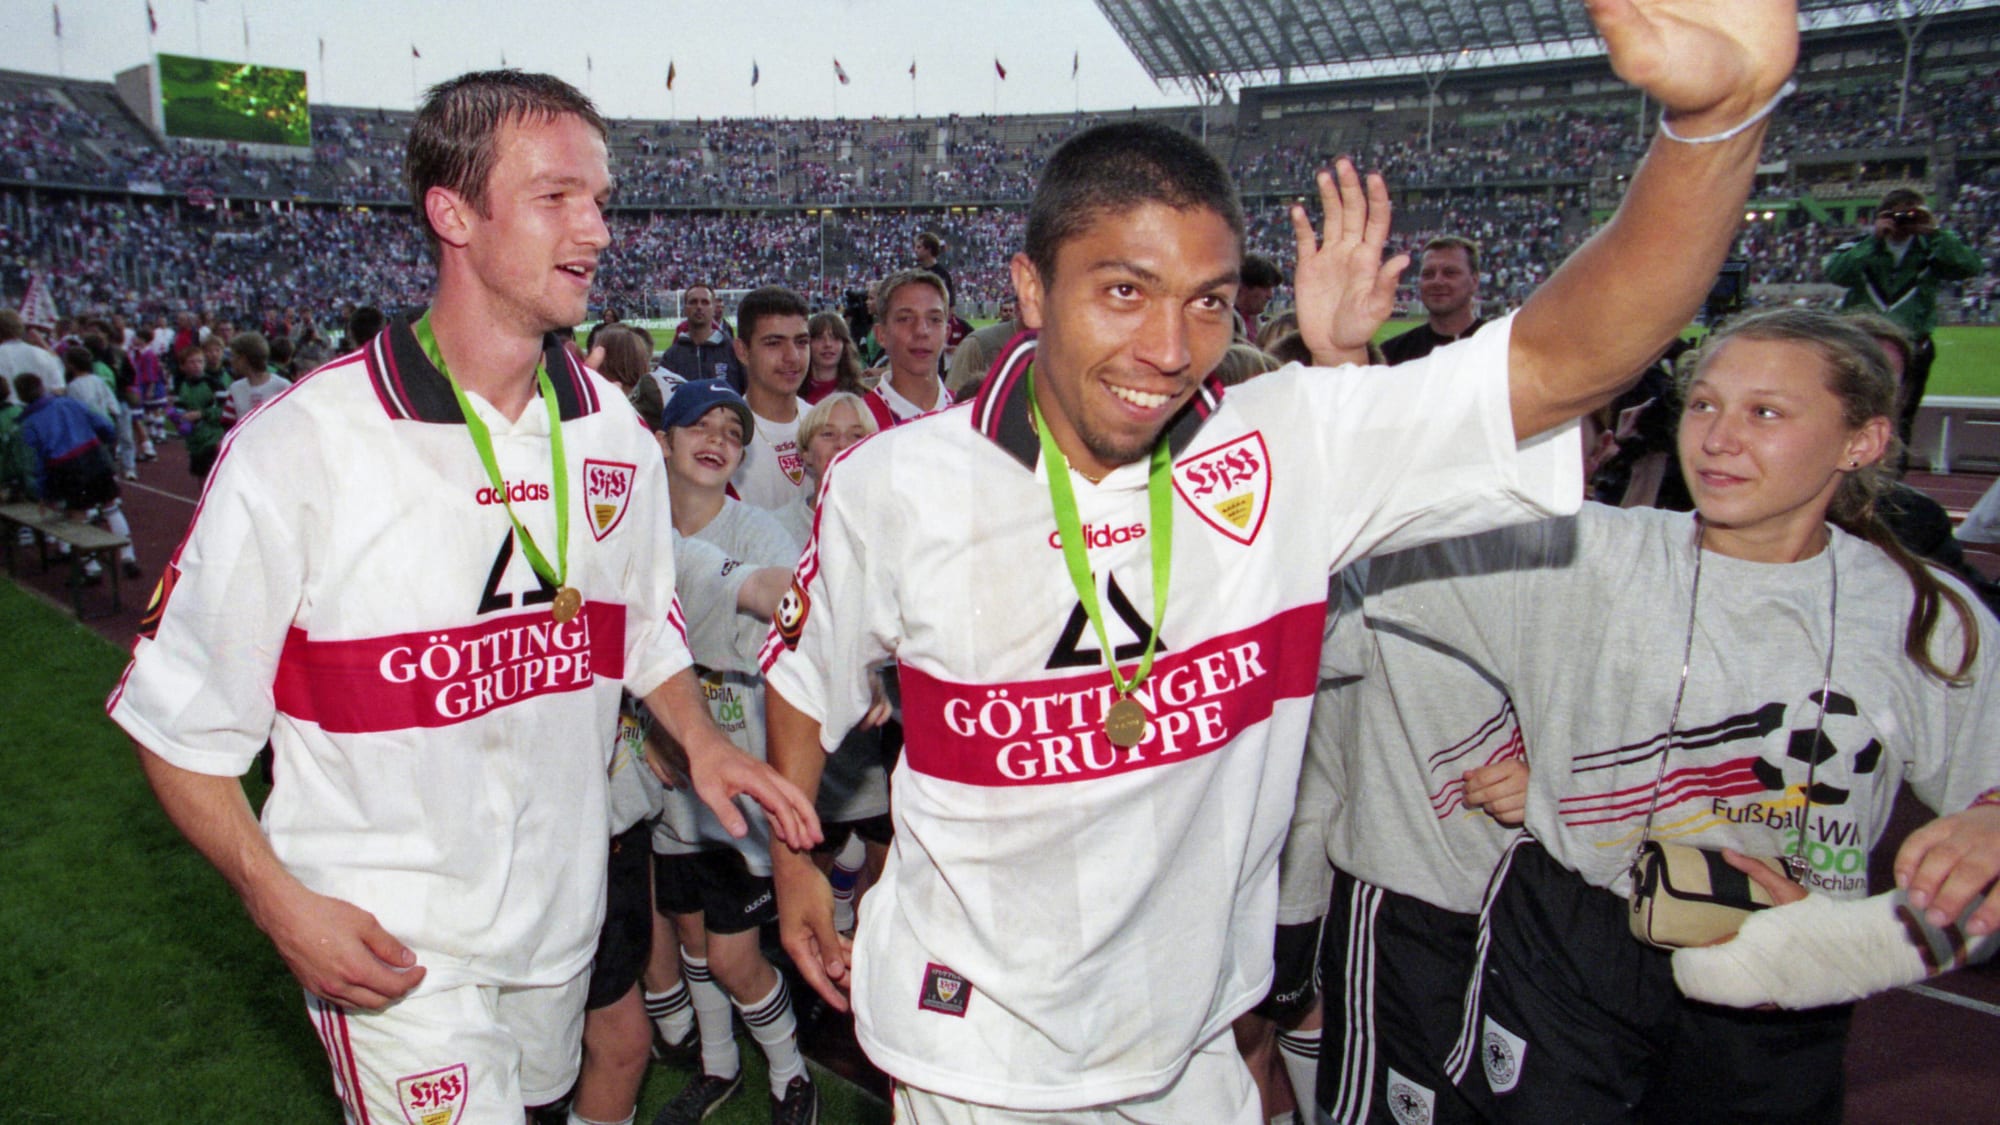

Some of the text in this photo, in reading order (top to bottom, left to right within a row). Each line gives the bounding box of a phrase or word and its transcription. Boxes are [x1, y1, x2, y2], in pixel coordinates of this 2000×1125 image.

[590, 467, 626, 499] VfB
[1186, 448, 1260, 499] VfB
[435, 649, 592, 718] GRUPPE
[944, 641, 1267, 740] GÖTTINGER
[996, 701, 1229, 781] GRUPPE
[410, 1073, 462, 1110] VfB
